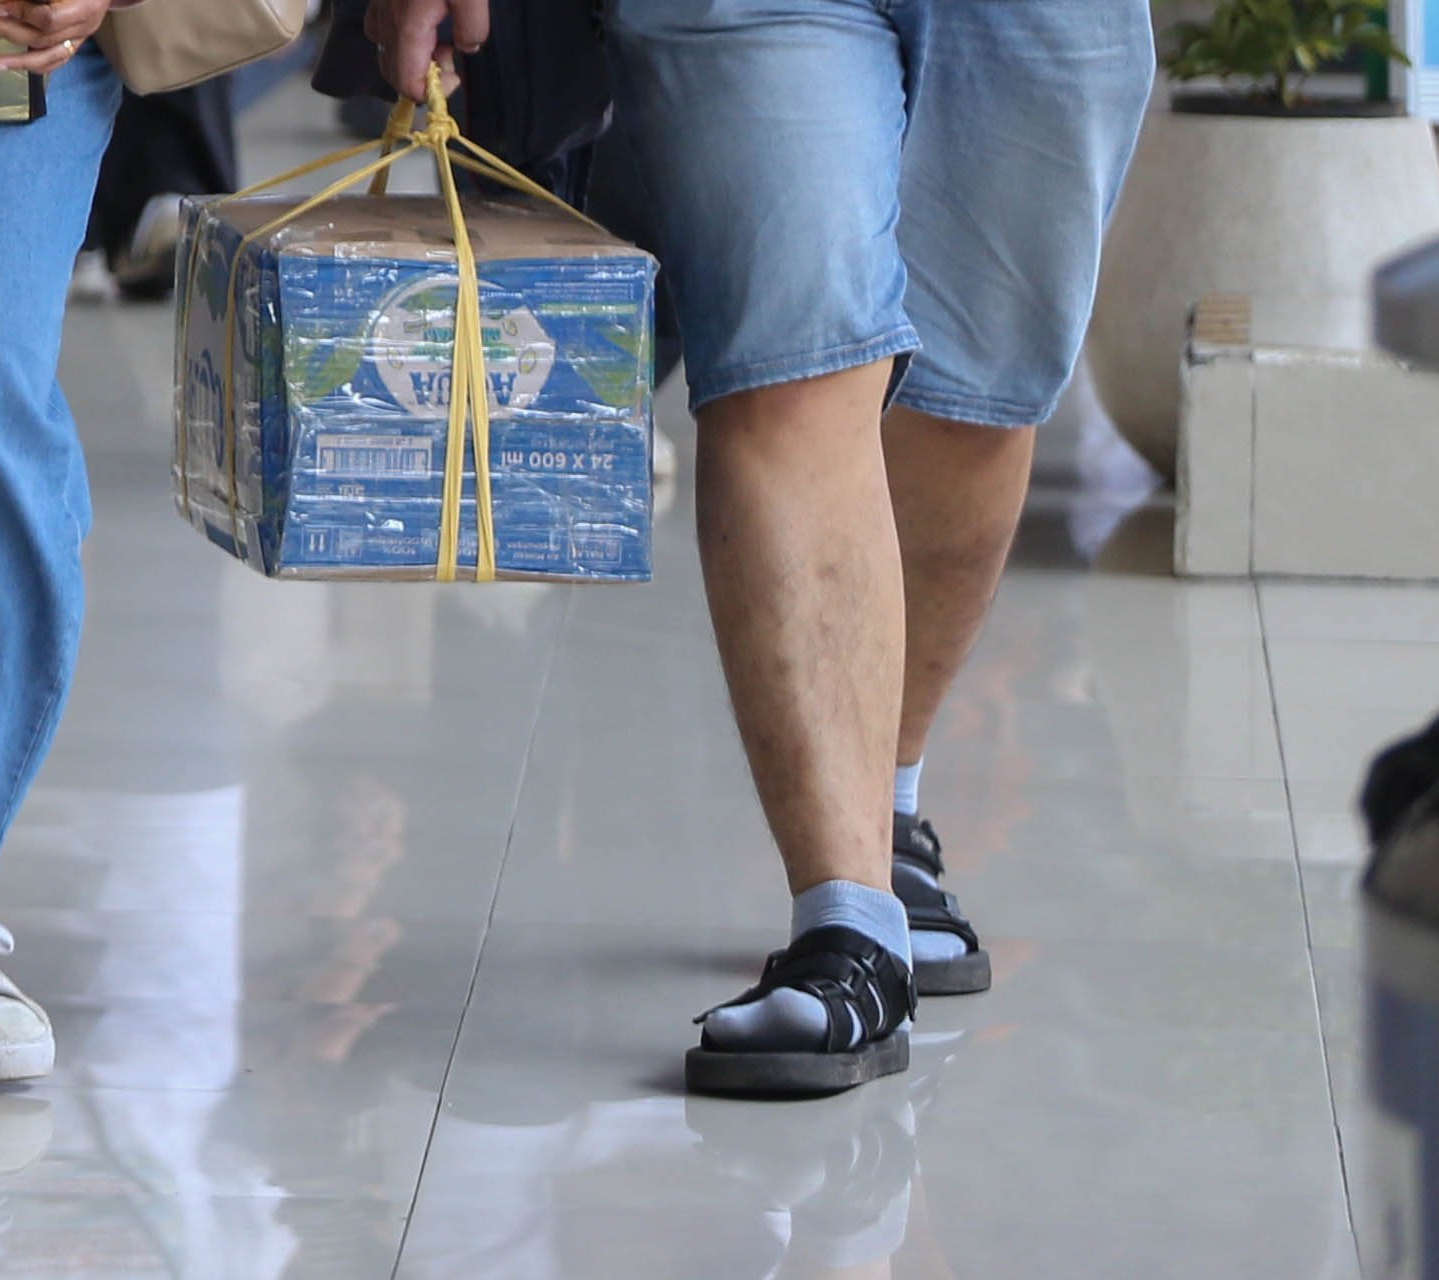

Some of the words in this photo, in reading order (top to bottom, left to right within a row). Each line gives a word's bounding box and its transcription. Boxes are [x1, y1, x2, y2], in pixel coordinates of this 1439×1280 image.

[409, 372, 518, 406] AUA
[501, 451, 523, 468] ml
[529, 452, 567, 470] 600
[591, 453, 613, 470] 24
